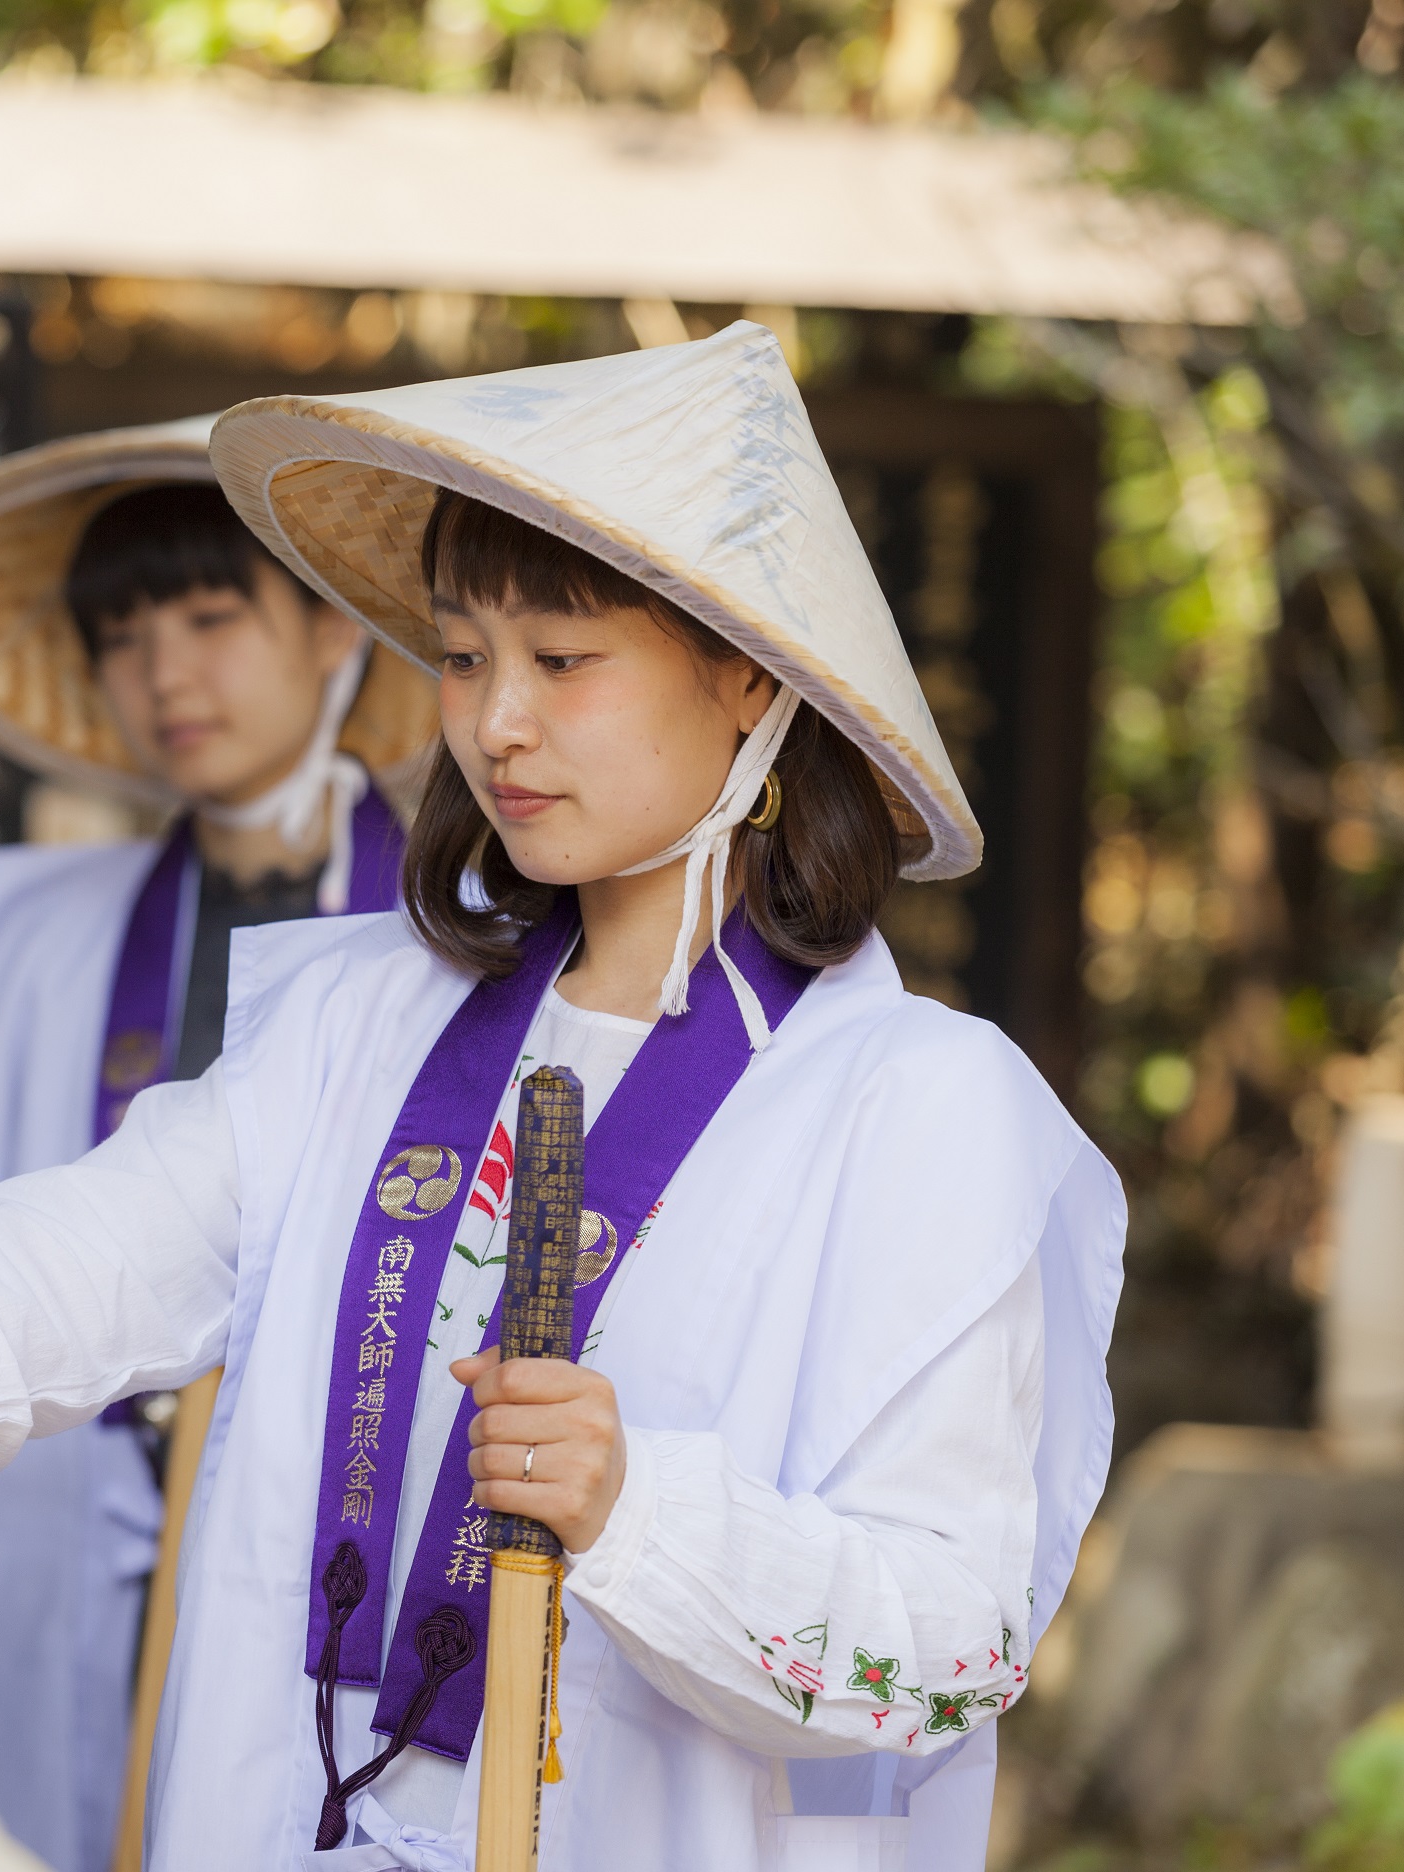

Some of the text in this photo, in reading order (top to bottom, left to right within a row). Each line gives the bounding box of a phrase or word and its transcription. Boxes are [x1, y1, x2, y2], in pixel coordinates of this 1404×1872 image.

[340, 1234, 415, 1529] 南無大師遍照金剛
[445, 1485, 494, 1593] 巡拝
